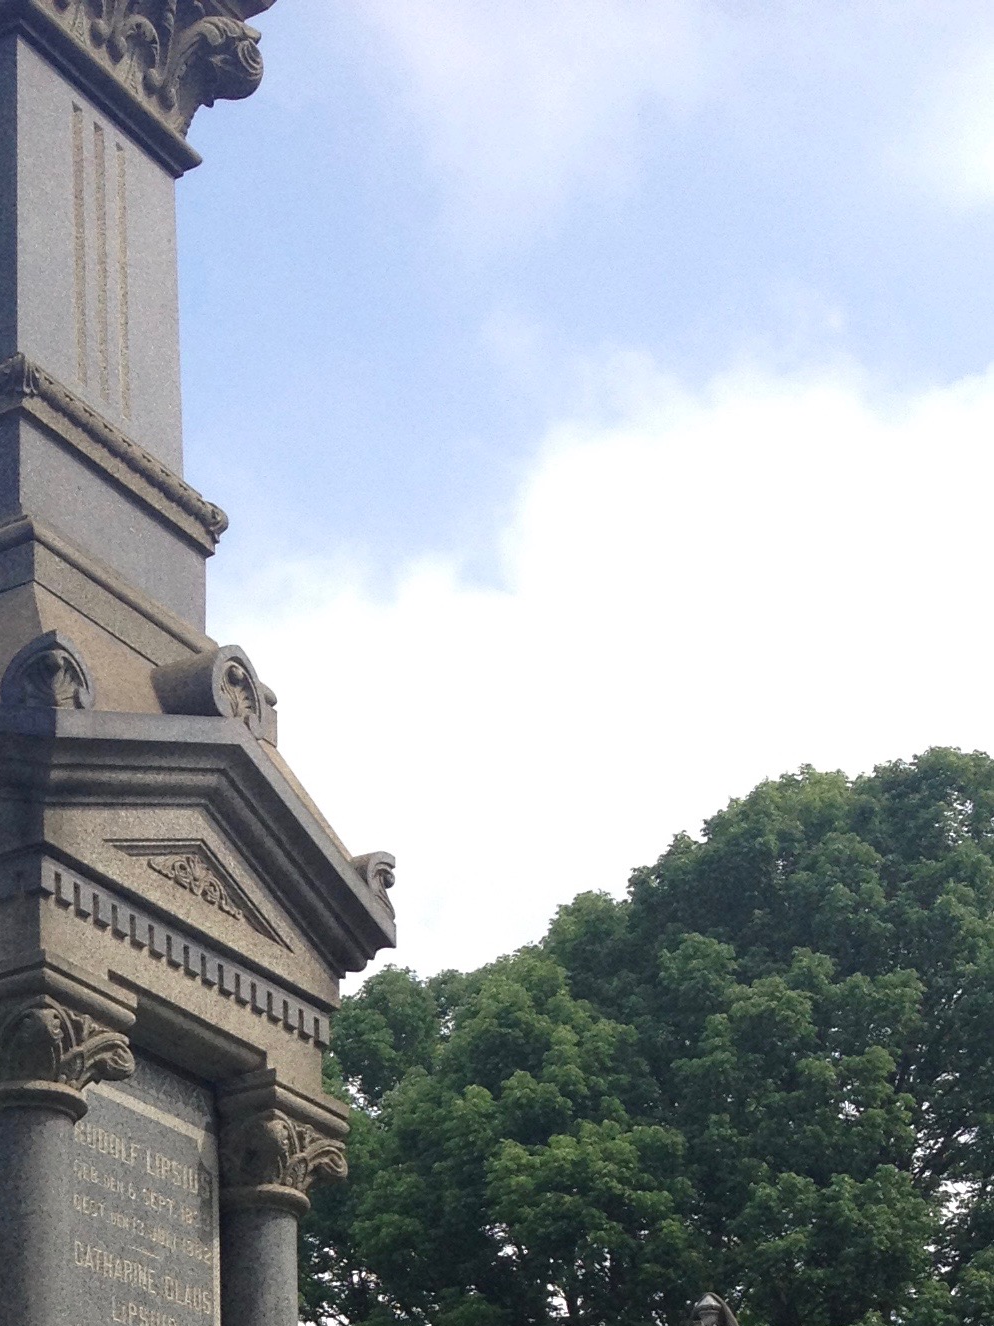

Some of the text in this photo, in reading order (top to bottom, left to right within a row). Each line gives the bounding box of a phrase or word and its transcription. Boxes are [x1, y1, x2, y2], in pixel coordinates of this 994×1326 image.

[74, 1121, 210, 1199] RUDOLF LIPSIUS
[74, 1240, 212, 1314] CATHARINE CLAUS
